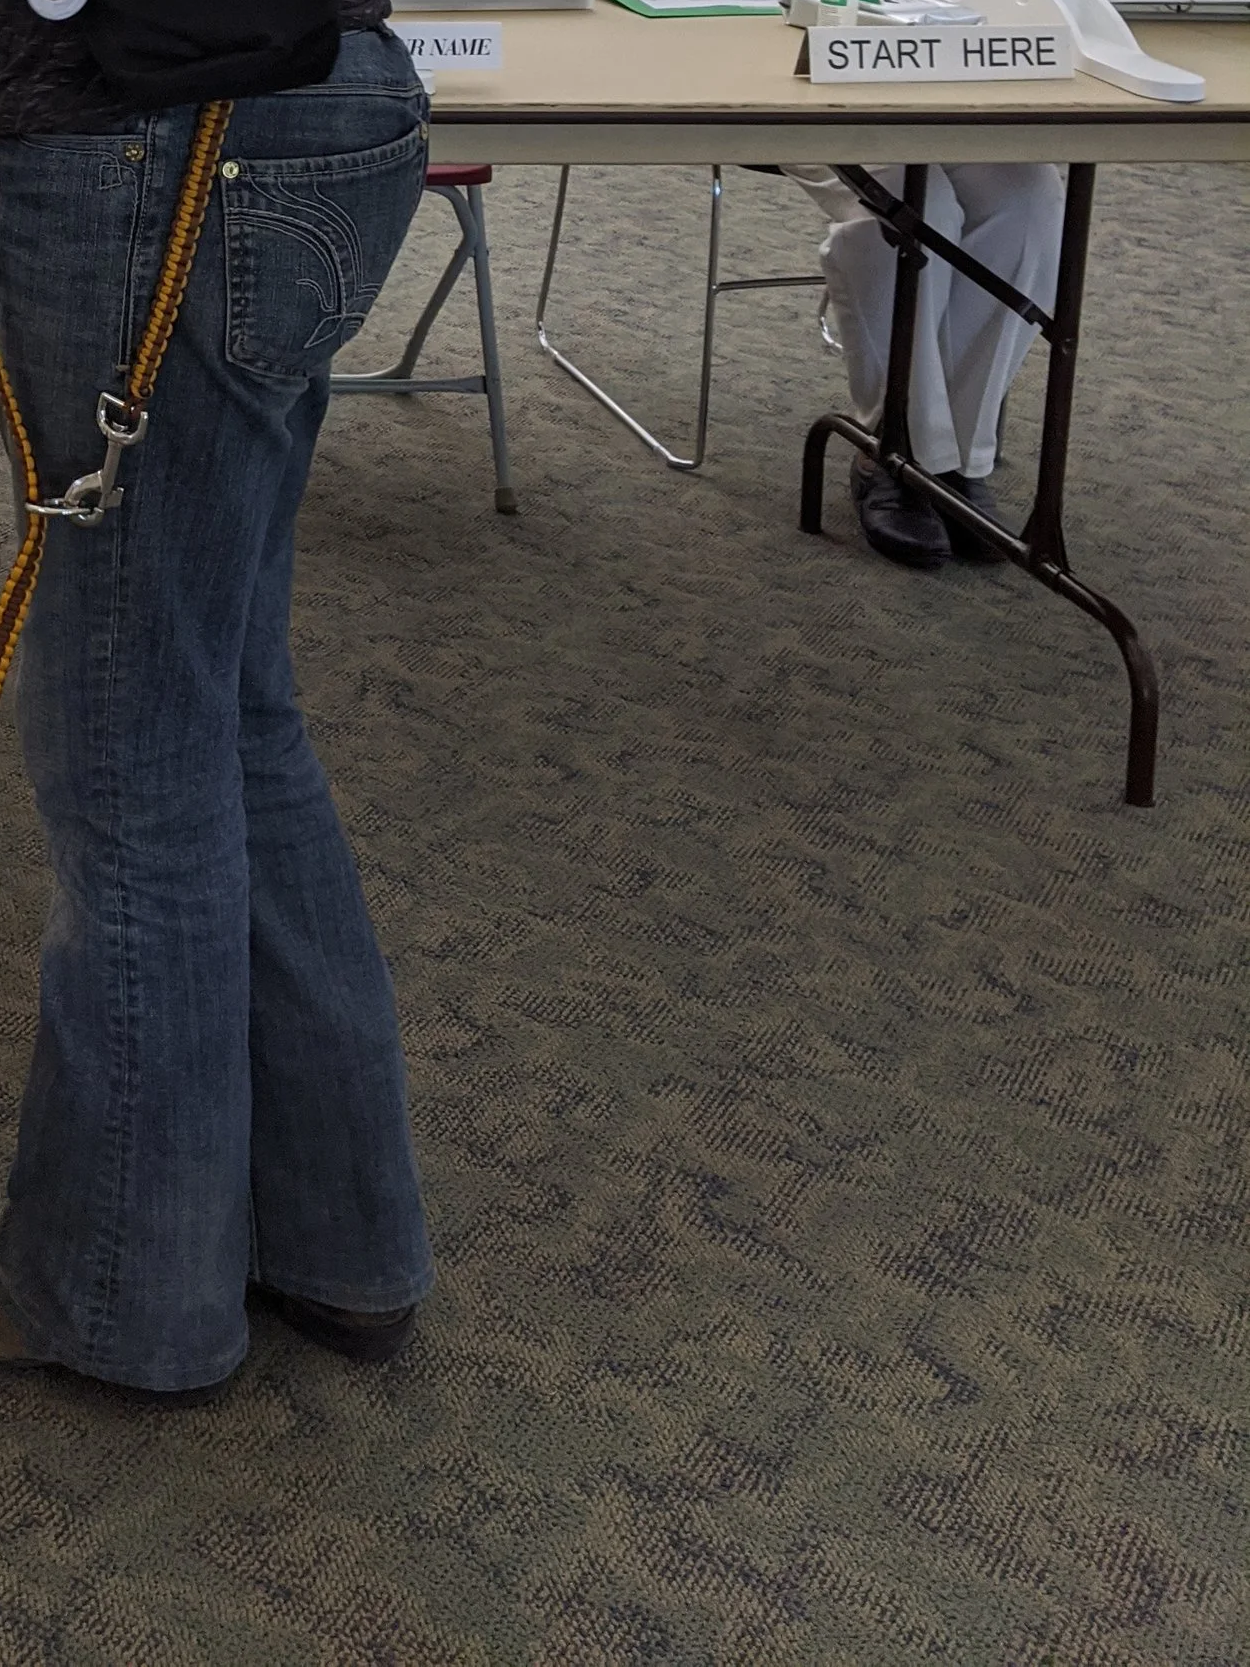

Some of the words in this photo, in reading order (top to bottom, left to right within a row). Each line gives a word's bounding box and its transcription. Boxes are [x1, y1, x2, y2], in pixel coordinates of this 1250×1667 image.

[430, 38, 492, 56] NAME
[828, 38, 942, 71] START
[963, 36, 1057, 69] HERE
